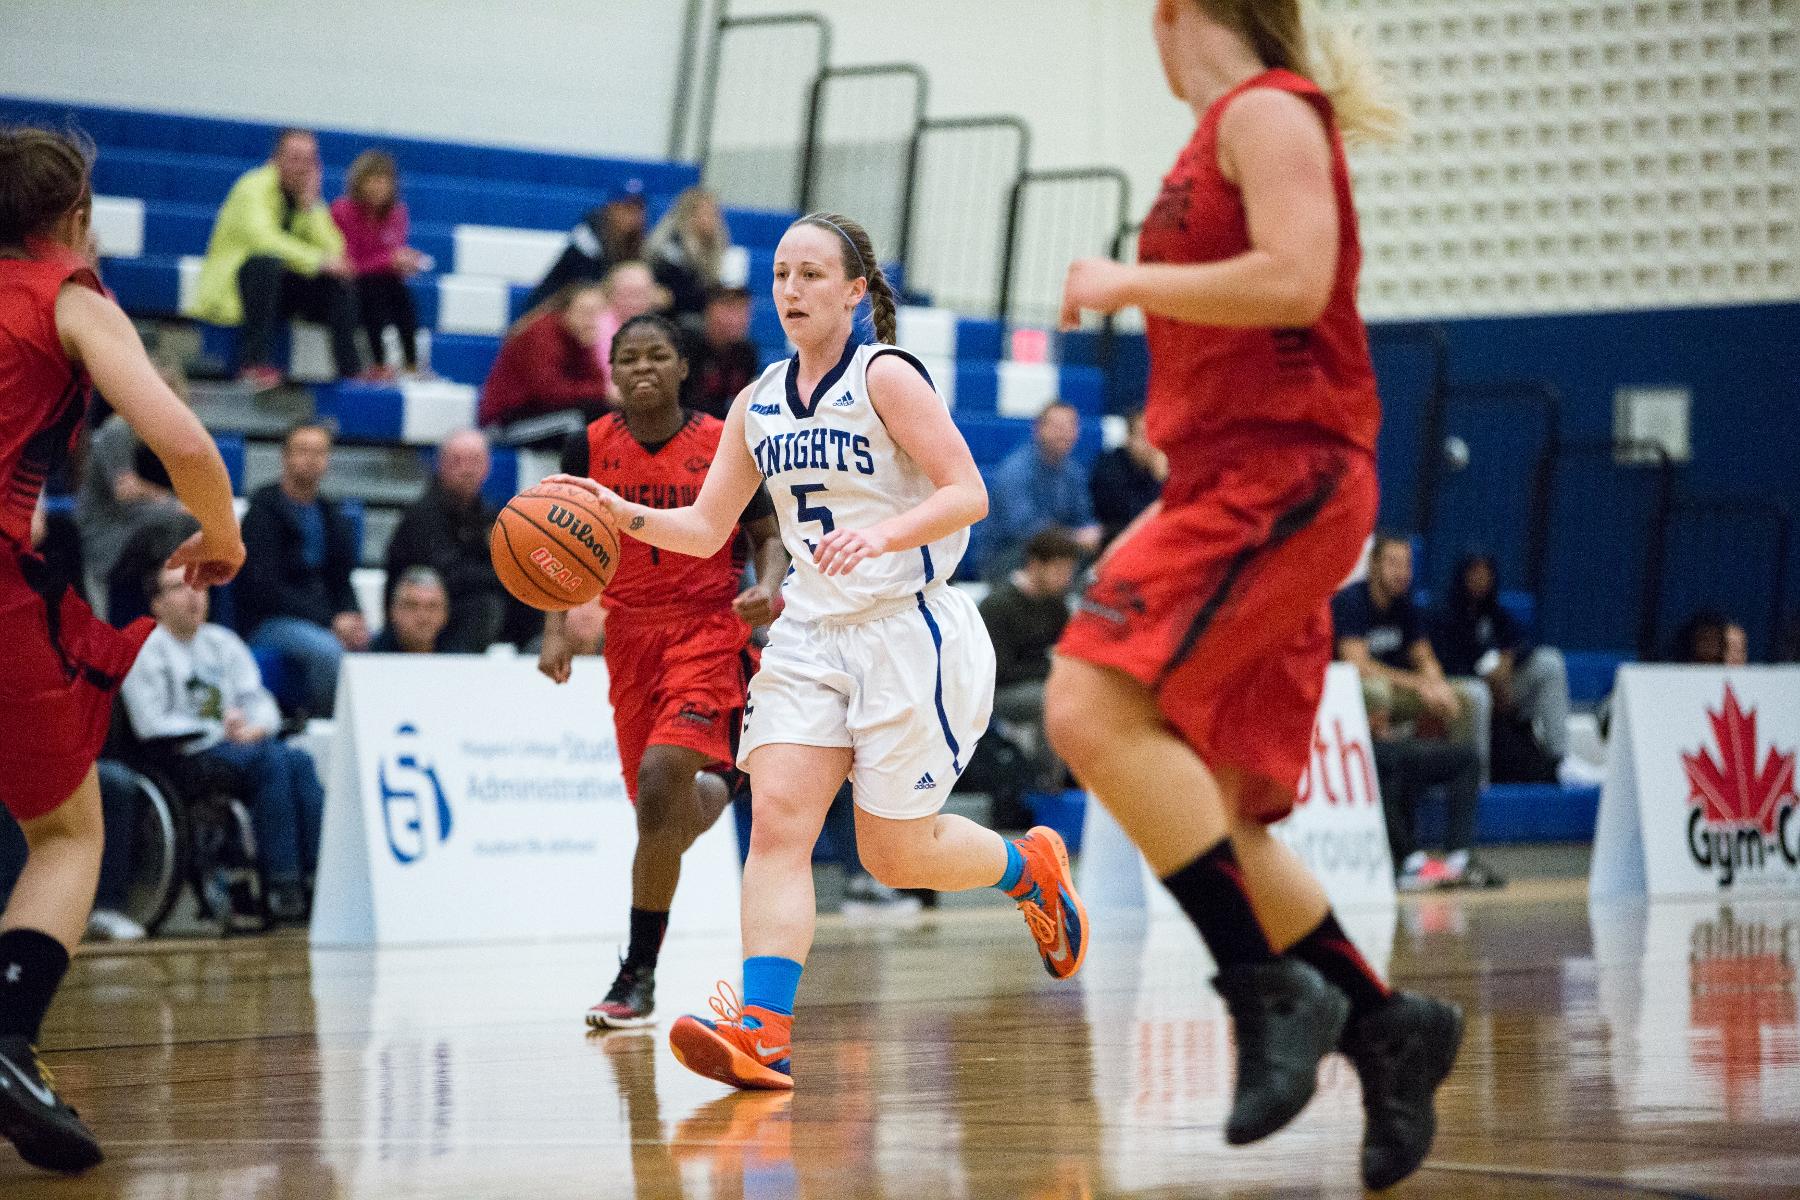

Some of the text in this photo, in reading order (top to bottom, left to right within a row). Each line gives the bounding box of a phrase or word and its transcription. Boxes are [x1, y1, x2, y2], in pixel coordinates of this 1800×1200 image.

[754, 428, 875, 480] KNIGHTS
[546, 504, 611, 570] Wilson
[790, 483, 835, 555] 5
[530, 546, 584, 593] OCAA
[1688, 804, 1800, 887] Gym-C
